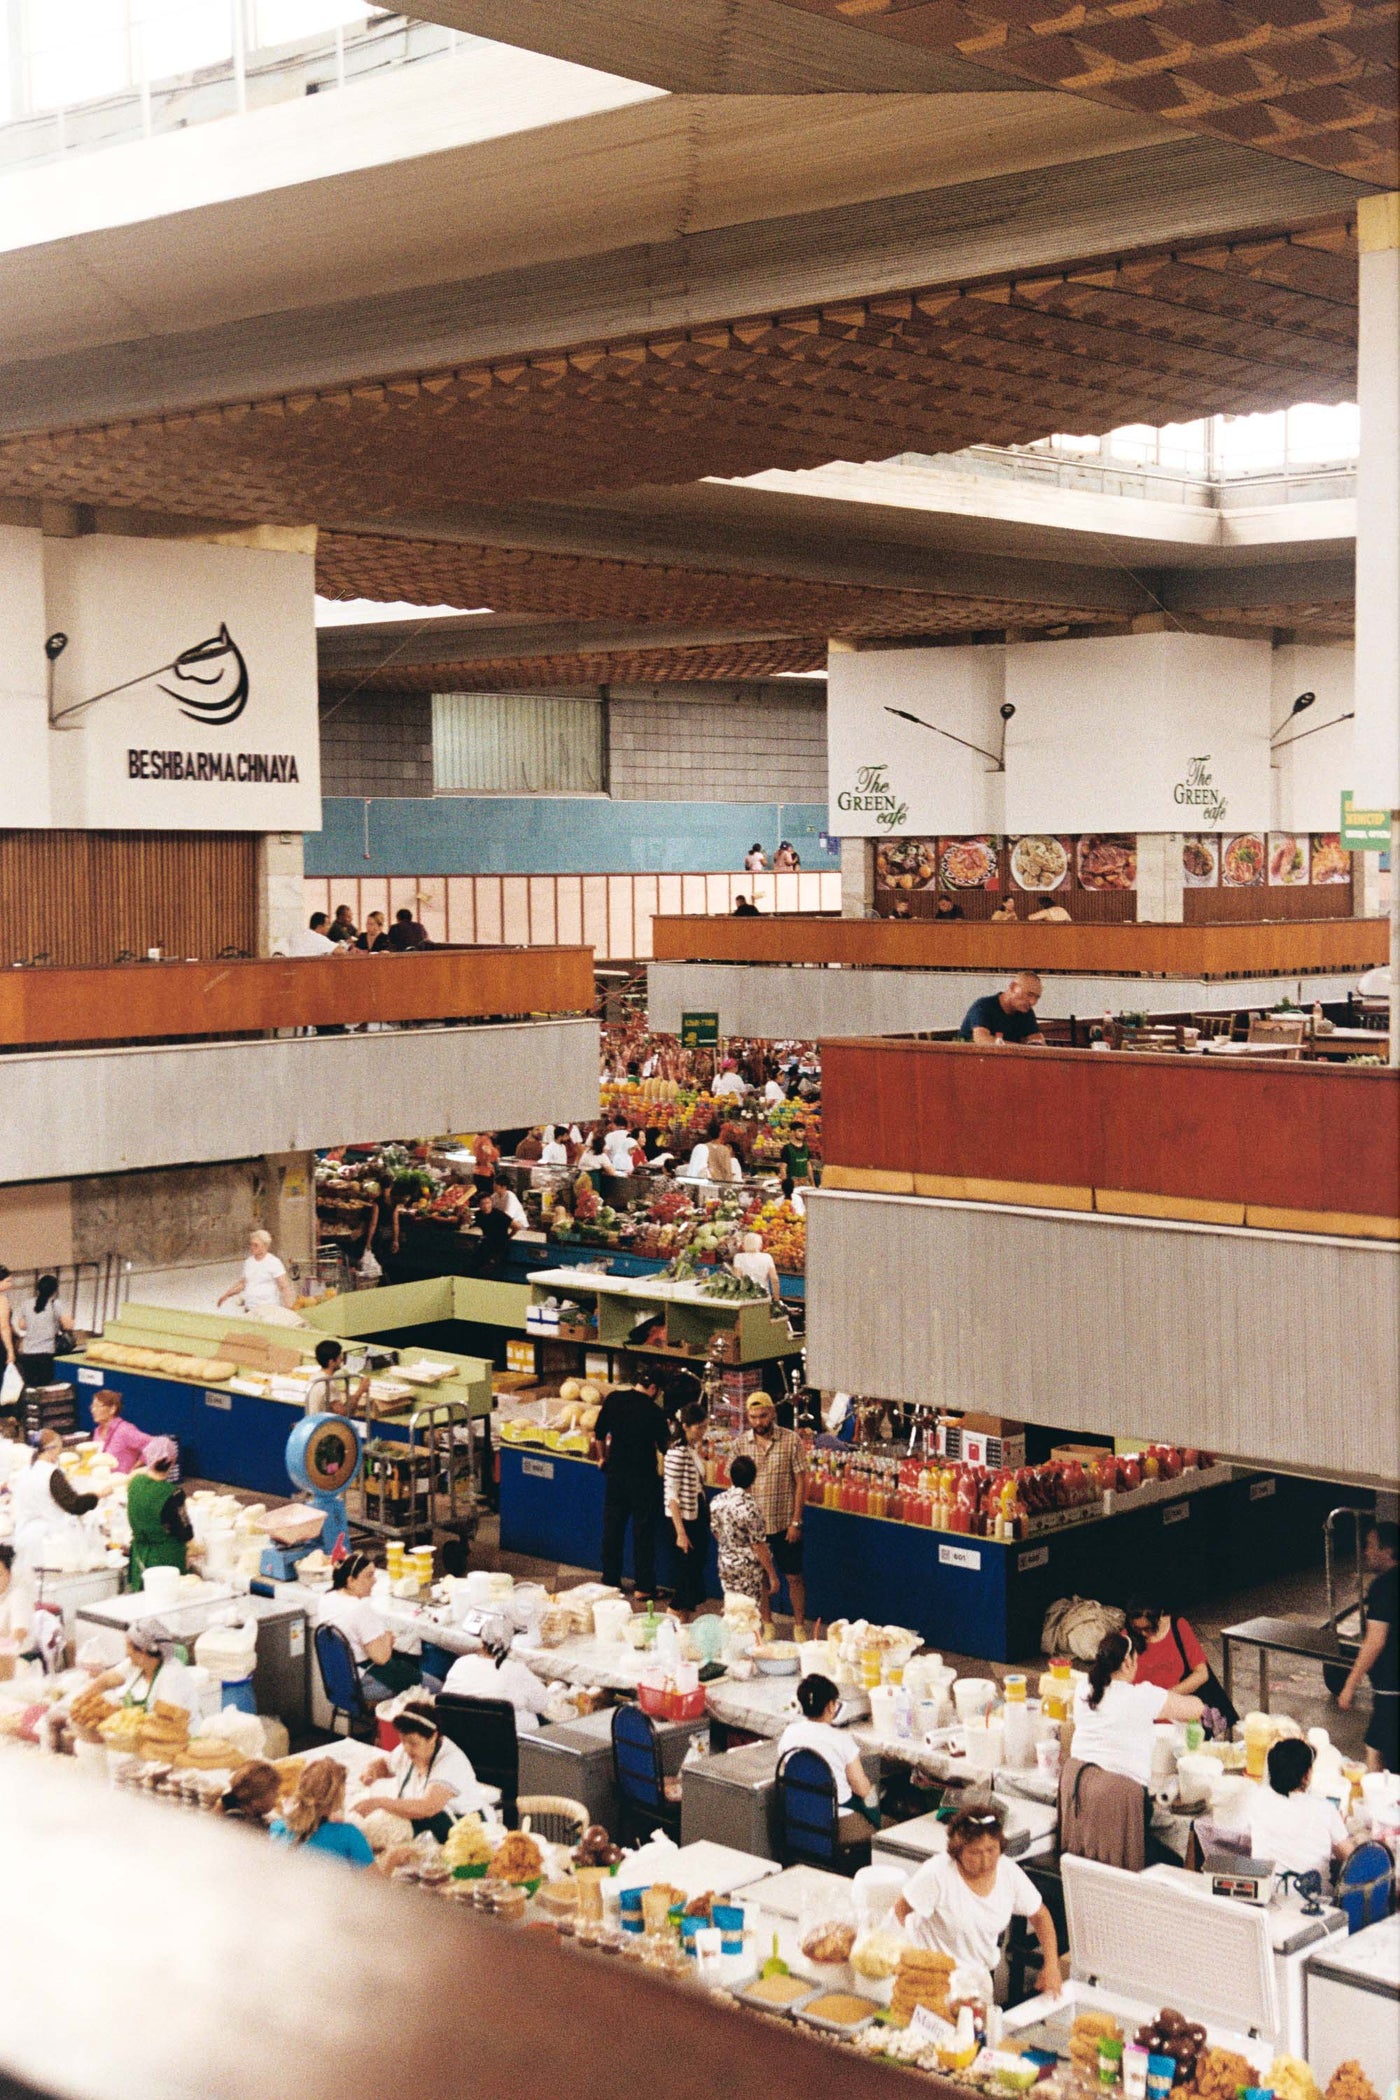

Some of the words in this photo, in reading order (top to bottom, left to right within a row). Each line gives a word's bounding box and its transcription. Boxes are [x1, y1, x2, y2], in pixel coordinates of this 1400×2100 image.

[128, 749, 299, 783] BESHBARMACHNAYA
[855, 764, 889, 794] The
[1186, 754, 1212, 786] The
[837, 791, 896, 811] GREEN
[1173, 783, 1219, 805] GREEN
[876, 802, 909, 834] café
